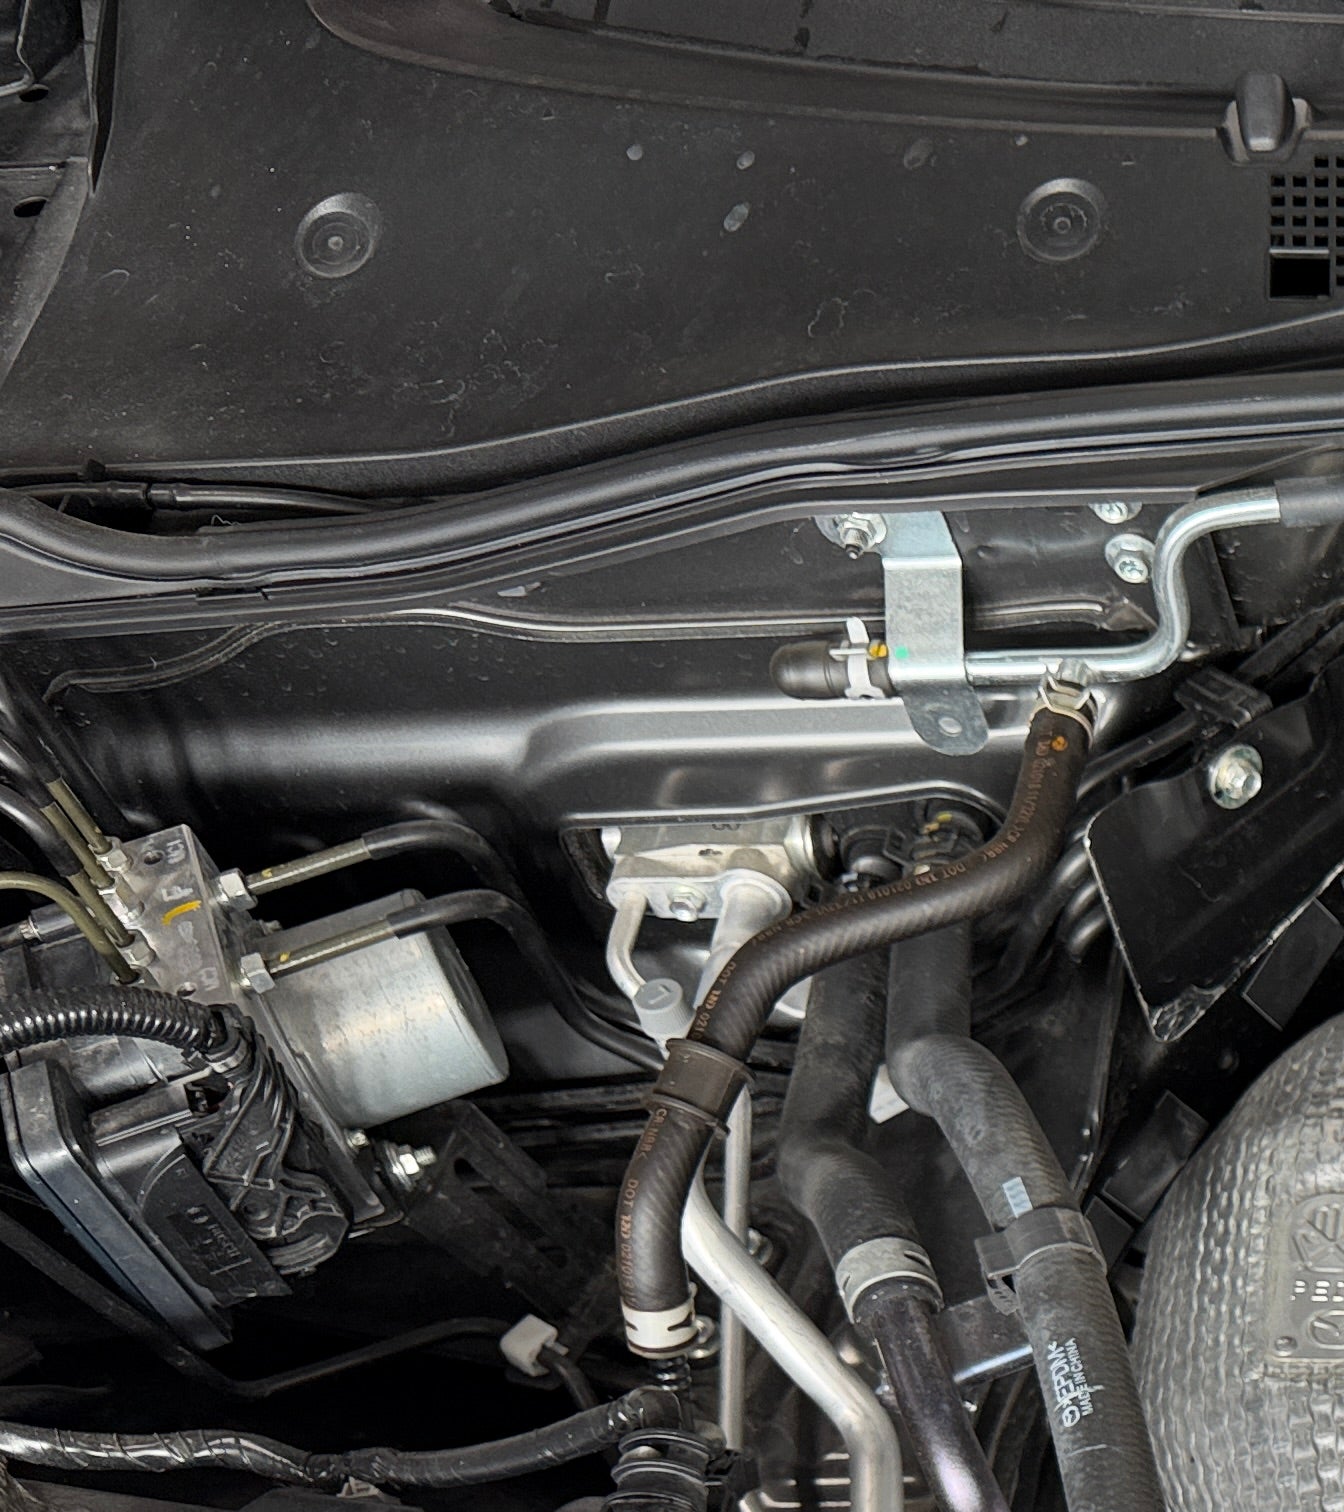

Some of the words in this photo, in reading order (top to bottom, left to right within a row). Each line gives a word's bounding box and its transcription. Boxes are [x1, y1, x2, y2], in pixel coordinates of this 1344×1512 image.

[623, 1178, 639, 1207] DOT
[1064, 1337, 1083, 1372] CHINA
[1072, 1371, 1086, 1384] IN
[1075, 1383, 1093, 1415] MADE
